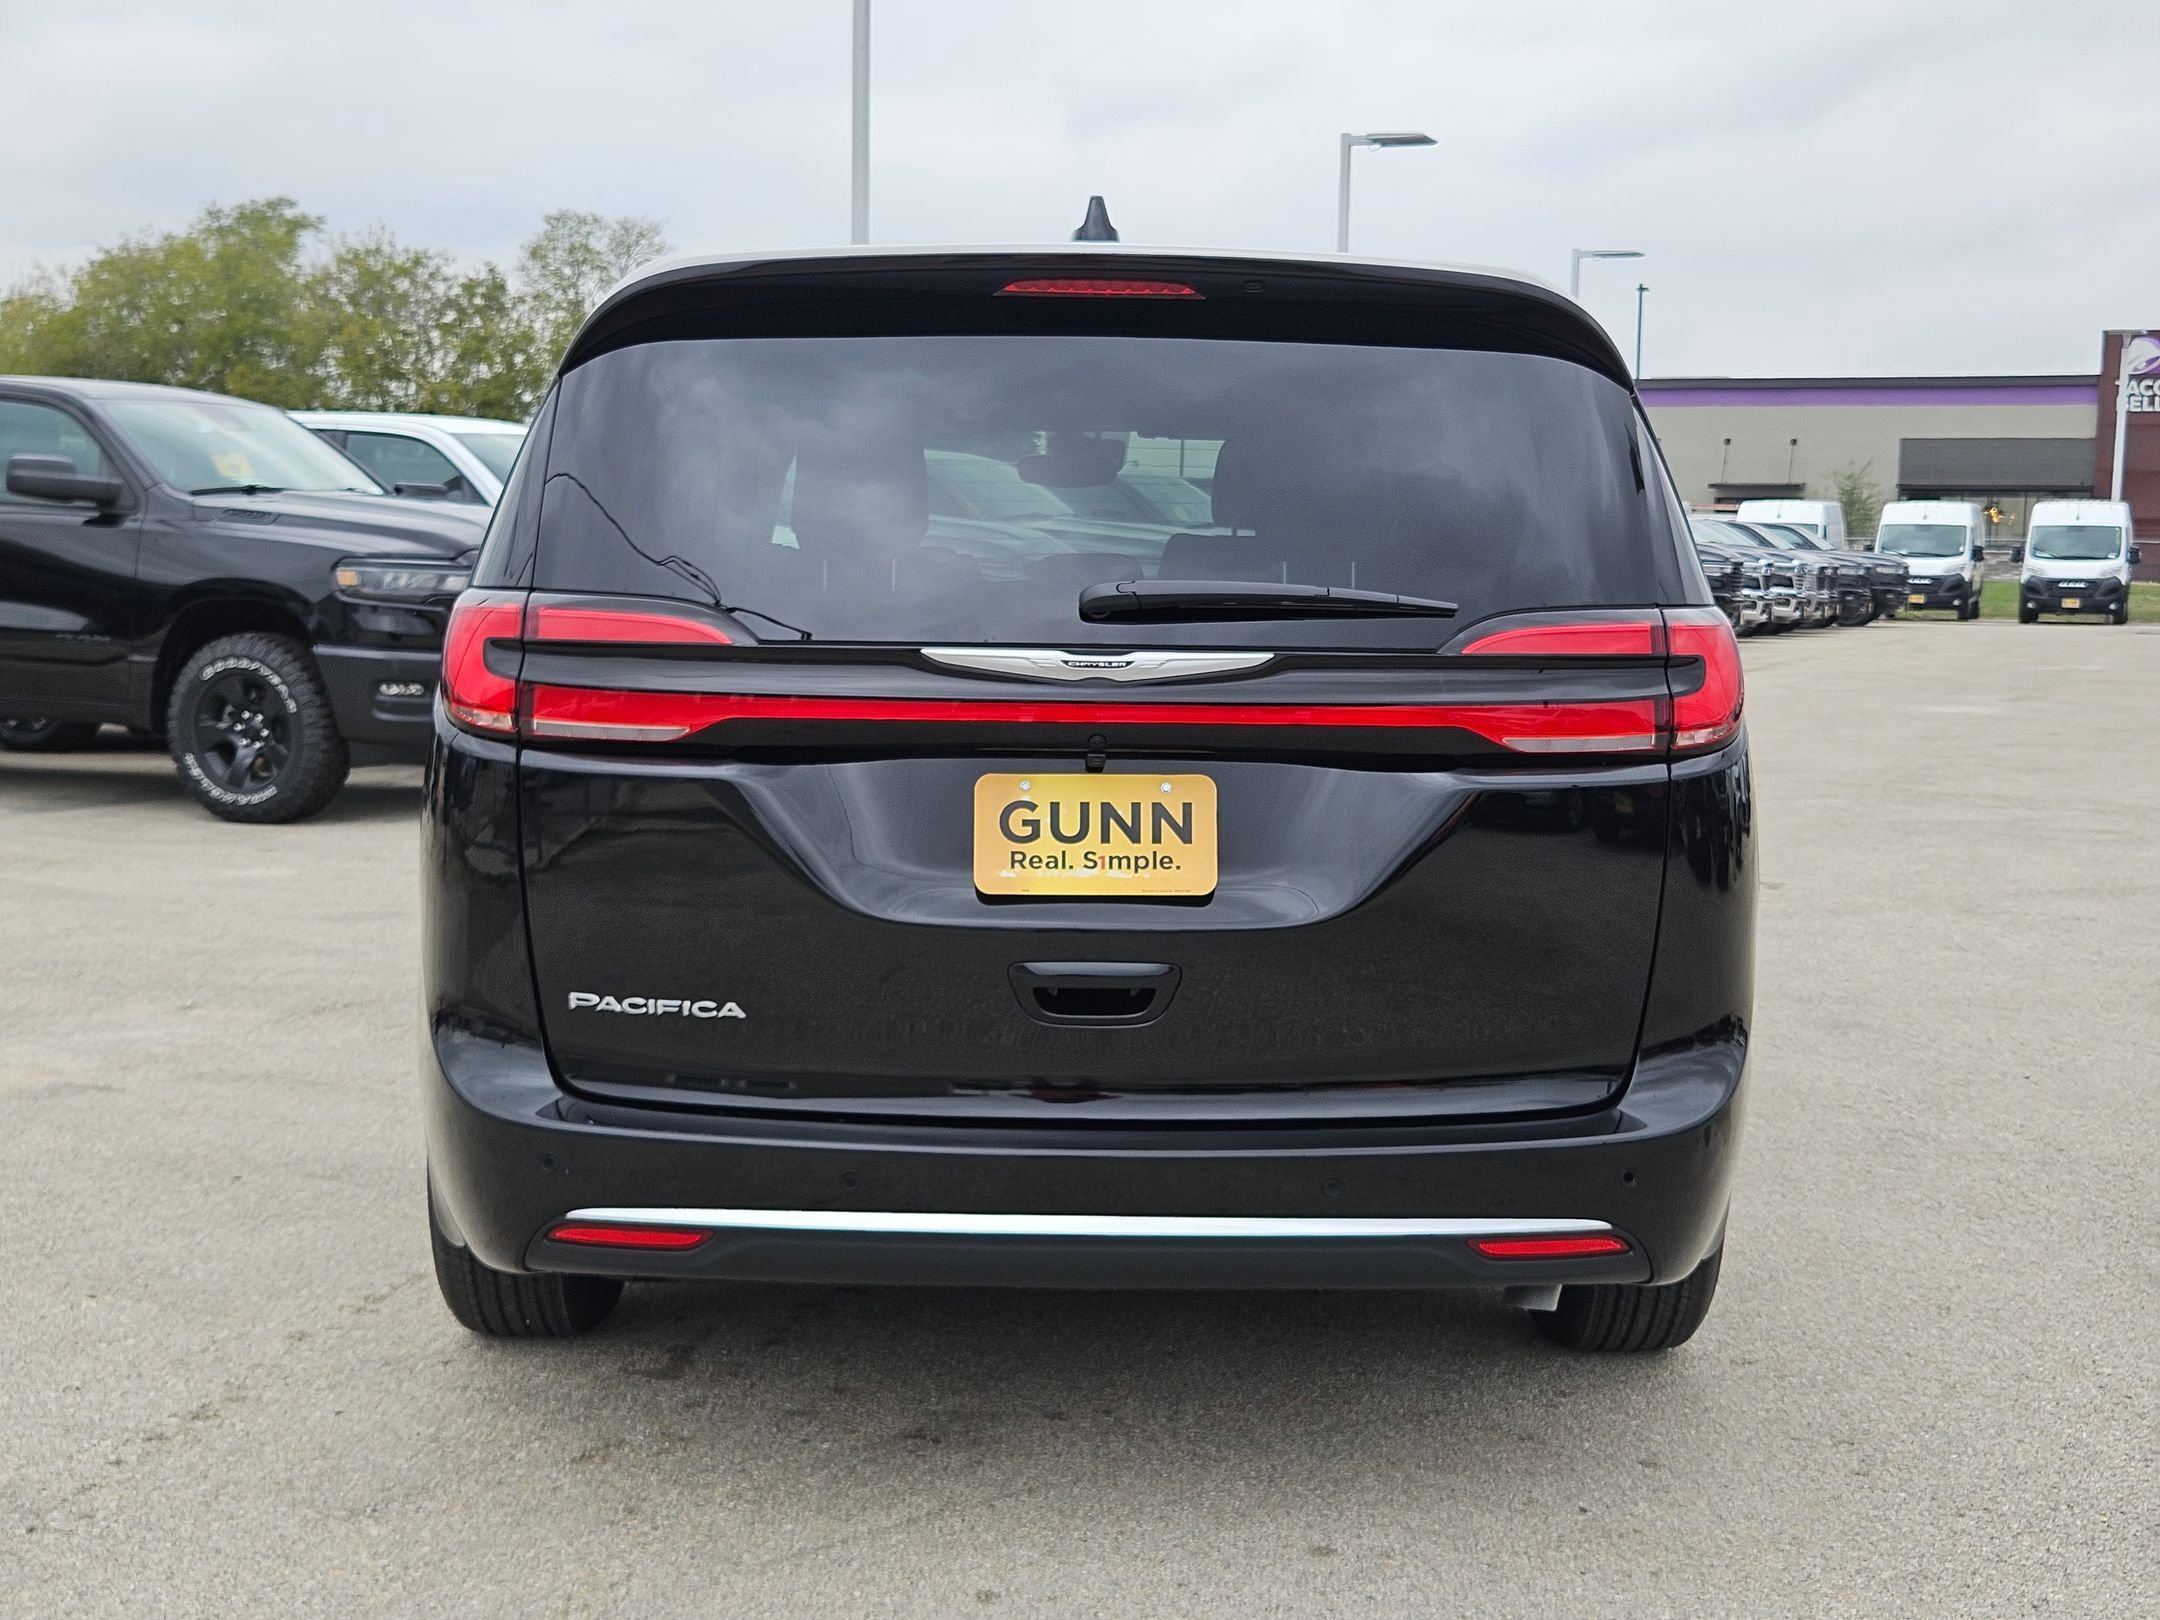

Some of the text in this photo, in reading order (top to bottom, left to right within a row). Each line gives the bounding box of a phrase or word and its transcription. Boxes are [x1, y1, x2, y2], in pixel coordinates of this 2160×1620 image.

[2114, 378, 2160, 396] AC
[2116, 396, 2160, 412] ELL
[999, 800, 1193, 845] GUNN
[1010, 851, 1181, 874] Real. S1mple.
[568, 991, 747, 1019] PACIFICA
